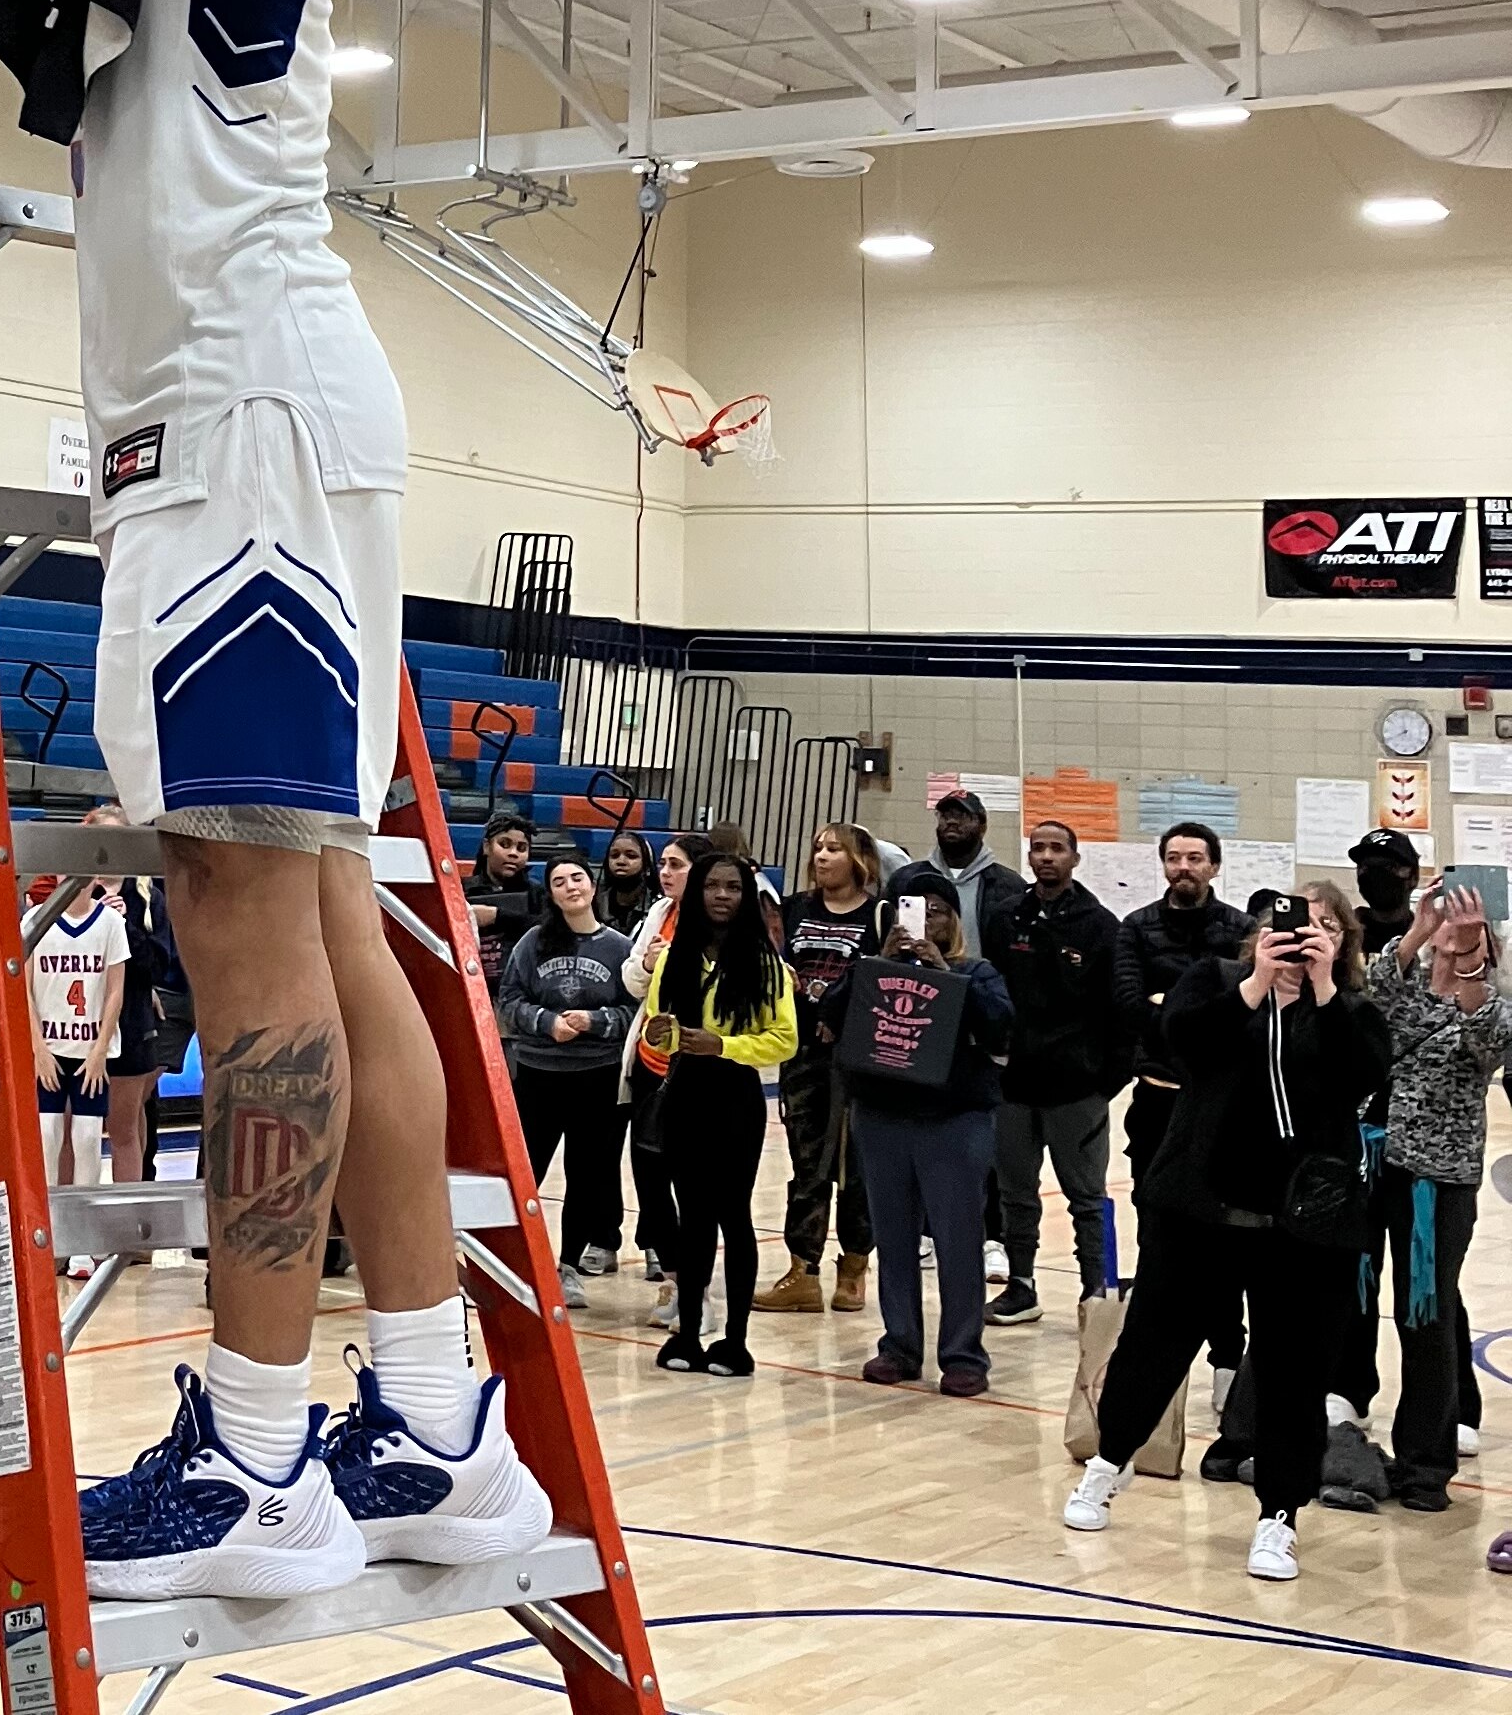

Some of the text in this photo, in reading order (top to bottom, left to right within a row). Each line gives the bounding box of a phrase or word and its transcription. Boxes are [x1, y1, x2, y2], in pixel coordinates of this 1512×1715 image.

[1326, 511, 1458, 552] ATI
[1319, 553, 1443, 565] PHYSICAL THERAPY
[40, 955, 104, 973] OVERLE
[66, 979, 87, 1017] 4
[10, 1611, 31, 1627] 375
